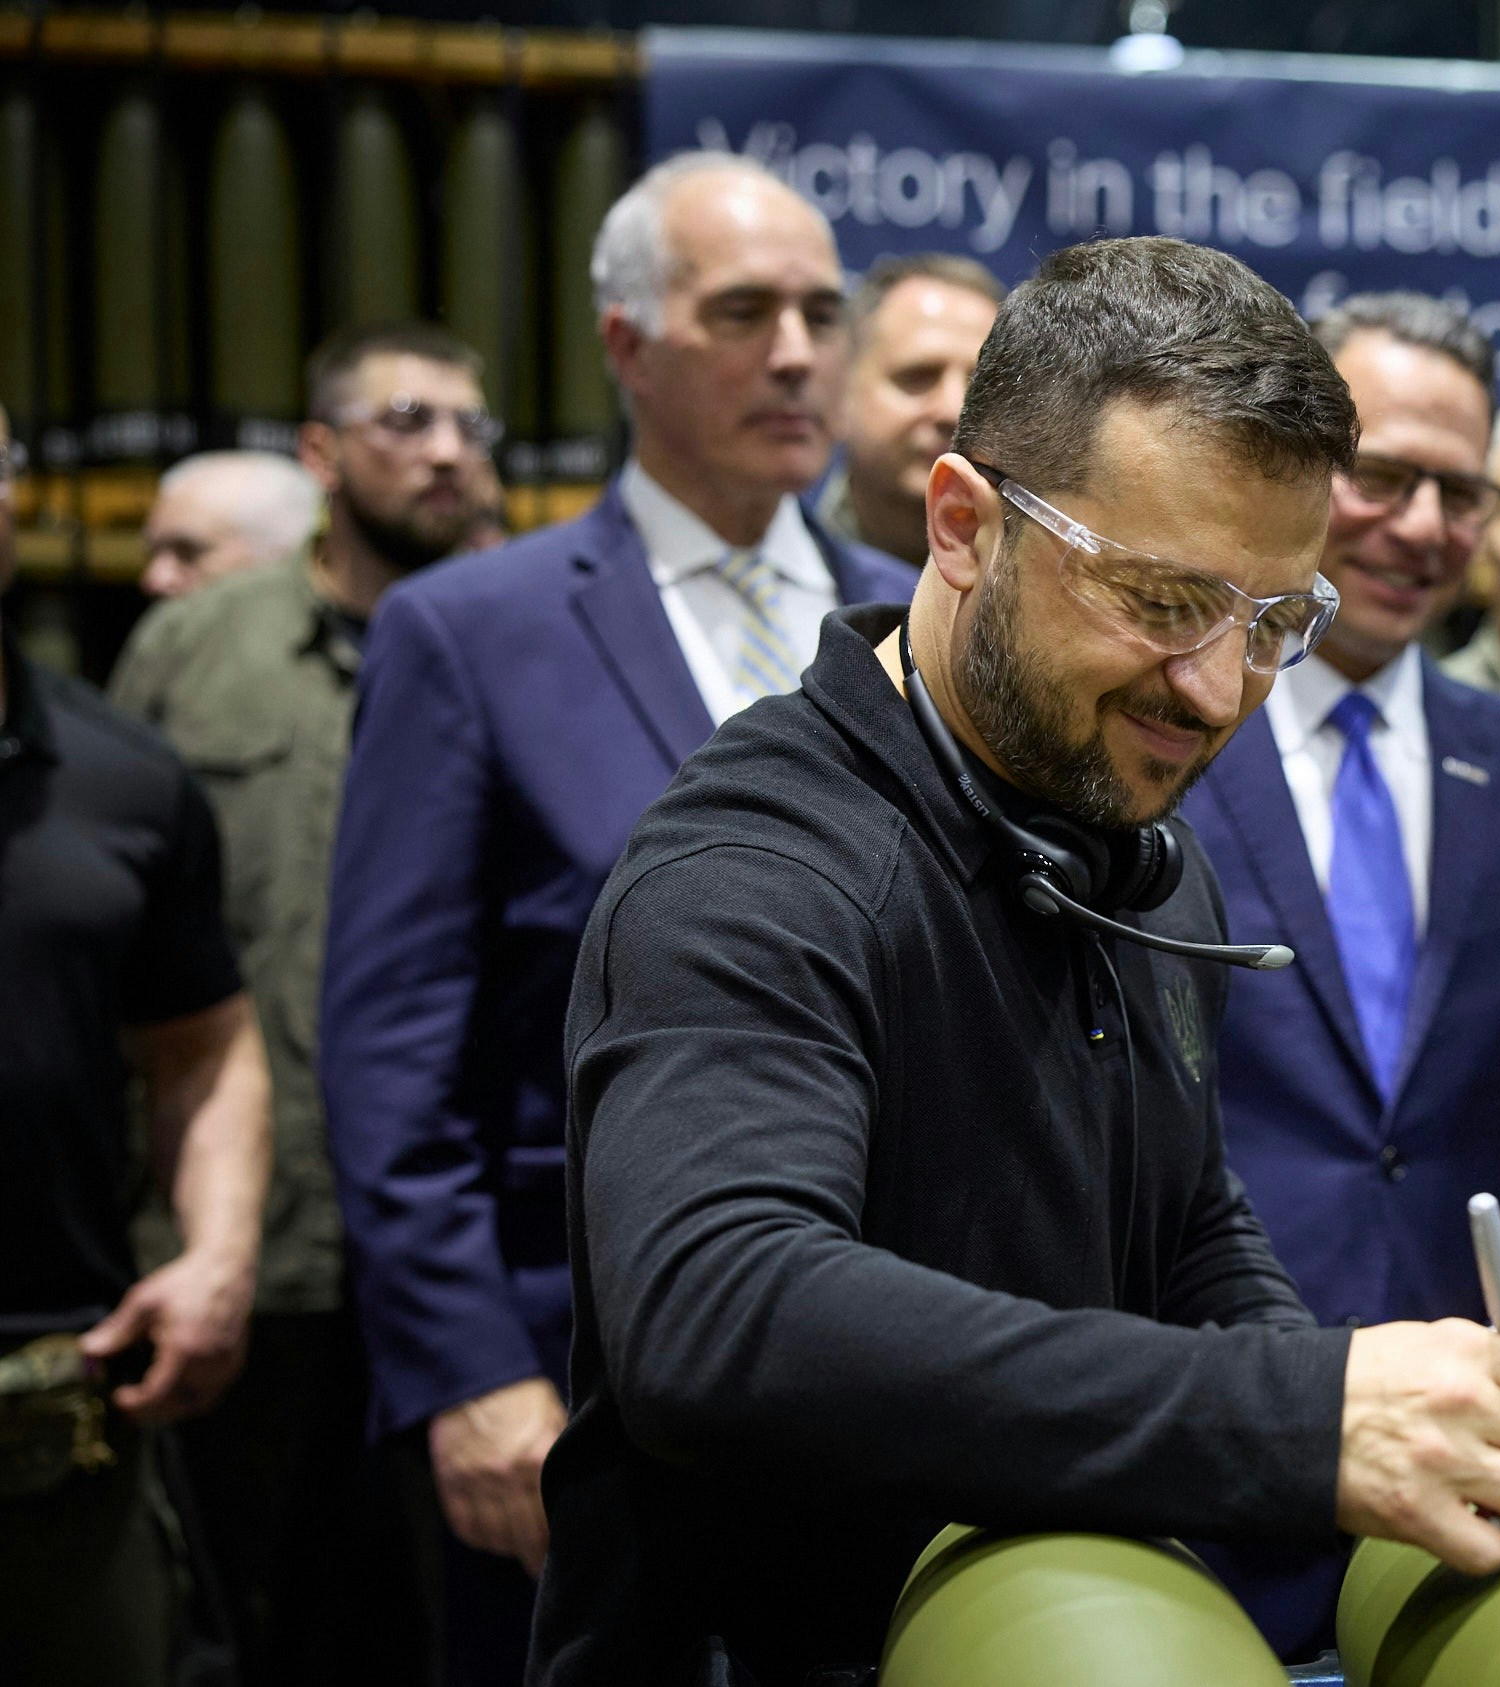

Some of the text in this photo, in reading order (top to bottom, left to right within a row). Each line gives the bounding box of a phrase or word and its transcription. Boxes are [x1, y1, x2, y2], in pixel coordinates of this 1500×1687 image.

[1047, 137, 1133, 236] in
[1147, 142, 1300, 248] the
[959, 782, 990, 817] LISTEN
